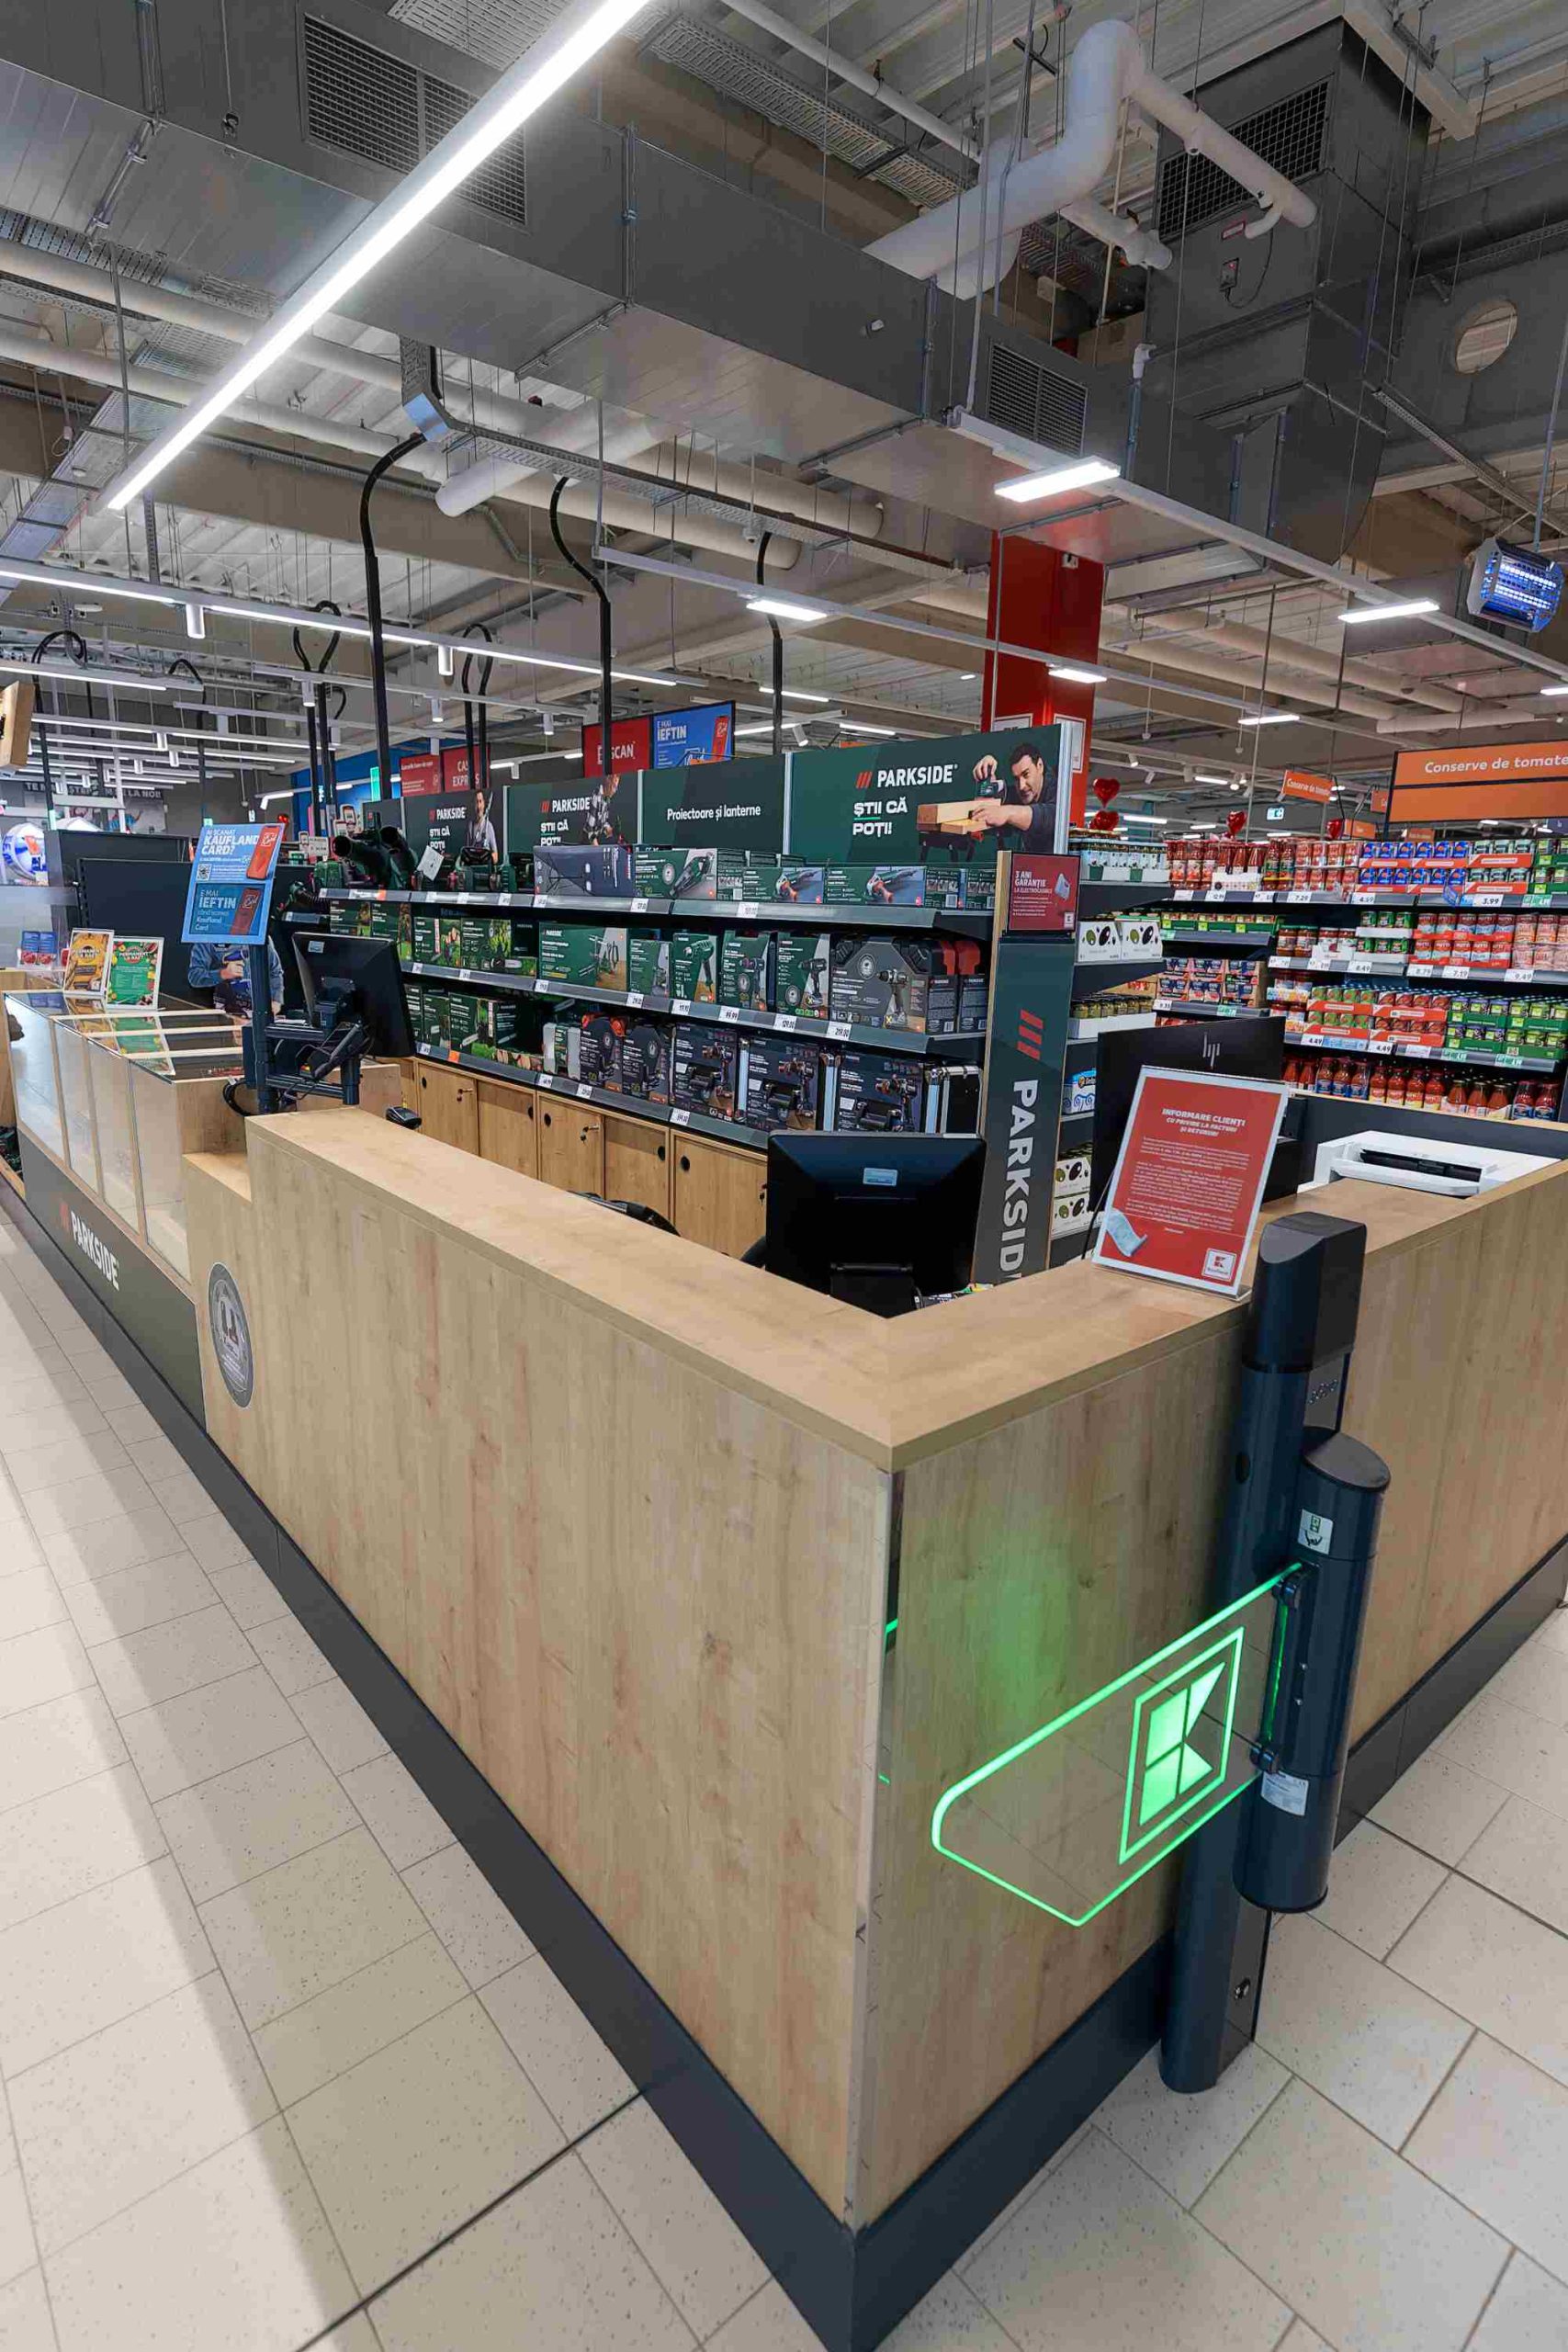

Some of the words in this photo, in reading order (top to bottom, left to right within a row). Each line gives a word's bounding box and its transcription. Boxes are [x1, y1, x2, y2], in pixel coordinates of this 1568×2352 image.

[657, 725, 687, 741] IEFTIN
[1425, 761, 1488, 774] Conserve
[1492, 757, 1510, 770] de
[877, 763, 953, 788] PARKSIDE
[552, 797, 591, 812] PARKSIDE
[667, 807, 714, 820] Proiectoare
[716, 805, 723, 821] și
[724, 804, 761, 818] lanterne
[853, 801, 882, 816] ȘTII
[886, 797, 908, 814] CĂ
[436, 807, 466, 820] PARKSIDE
[852, 821, 893, 837] POȚI!
[204, 834, 259, 845] KAUFLAND
[201, 844, 236, 855] CARD?
[198, 897, 237, 909] IEFTIN
[1161, 1108, 1212, 1121] INFORMARE
[999, 1079, 1039, 1280] PARKSID
[71, 1210, 119, 1291] PARKSIDE
